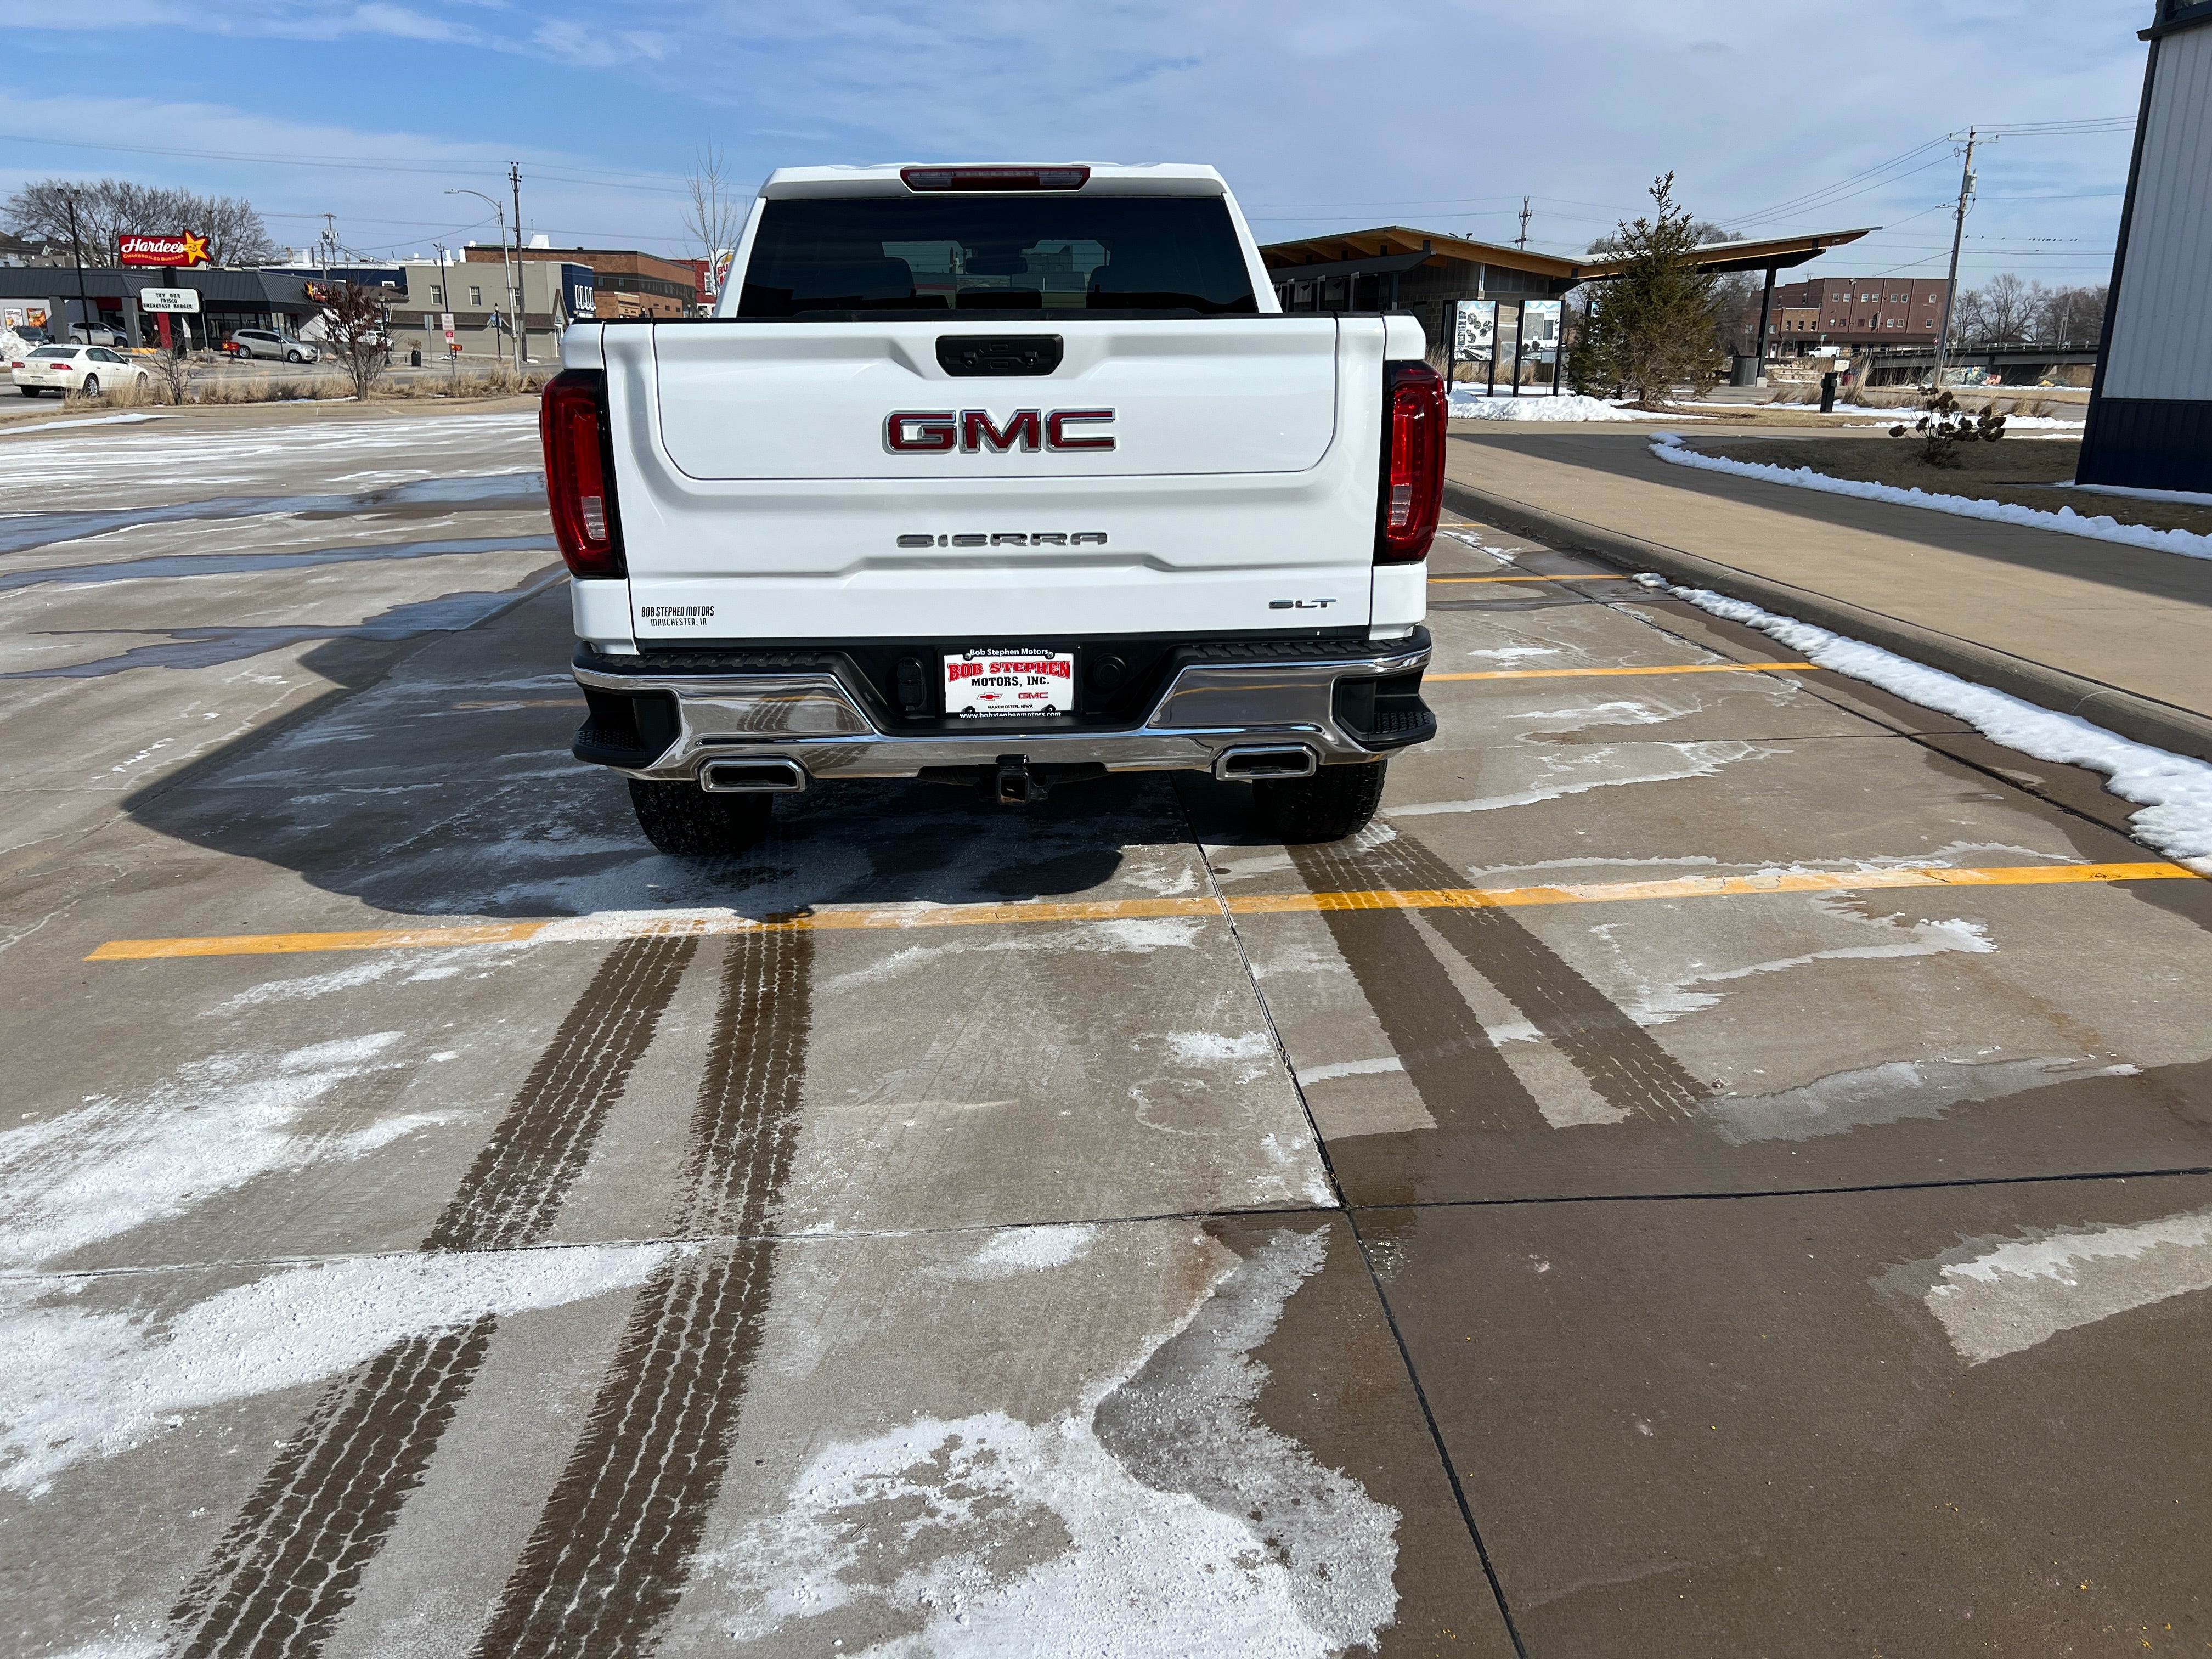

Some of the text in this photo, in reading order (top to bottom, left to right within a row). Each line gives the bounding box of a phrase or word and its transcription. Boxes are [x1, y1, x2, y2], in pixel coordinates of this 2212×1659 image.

[121, 238, 184, 253] Hardee's
[882, 408, 1116, 455] GMC
[896, 532, 1108, 548] SIERRA
[1268, 599, 1337, 609] SLT
[641, 606, 714, 617] BOB STEPHEN MOTORS
[700, 618, 707, 626] IA
[987, 648, 1020, 657] Stephen
[947, 661, 1071, 682] BOB STEPHEN
[971, 676, 1049, 687] MOTORS, INC.
